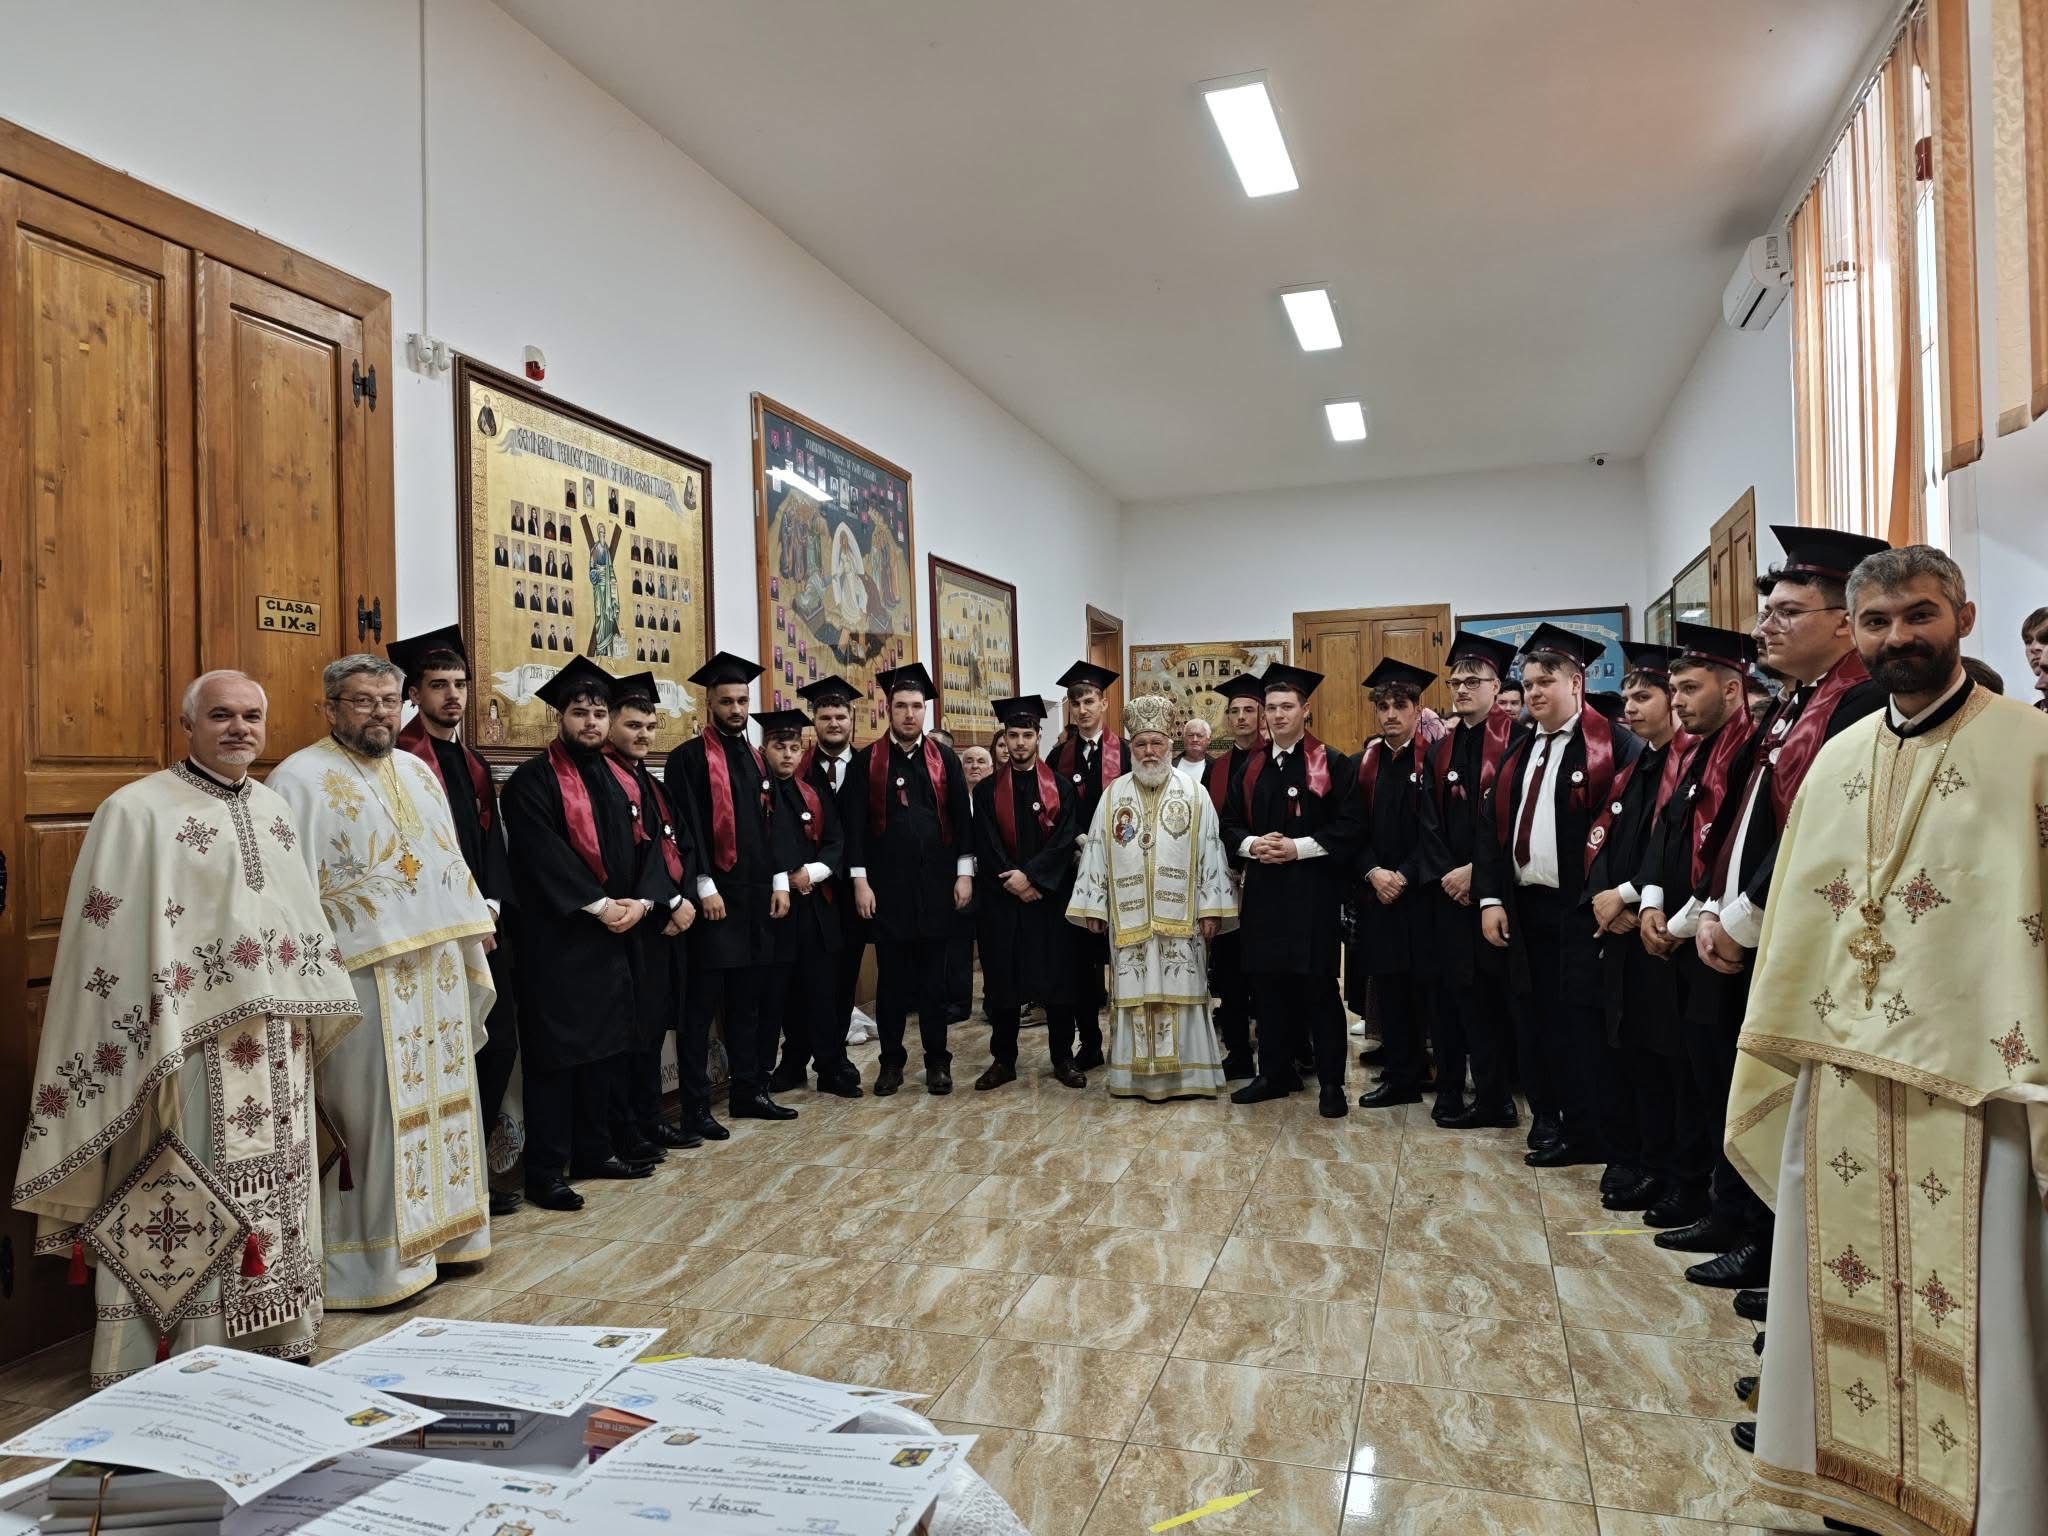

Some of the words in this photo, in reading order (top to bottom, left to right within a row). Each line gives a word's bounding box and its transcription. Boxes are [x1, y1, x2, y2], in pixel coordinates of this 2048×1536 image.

[266, 600, 313, 615] CLASA
[263, 616, 274, 627] a
[281, 615, 316, 632] IX-a
